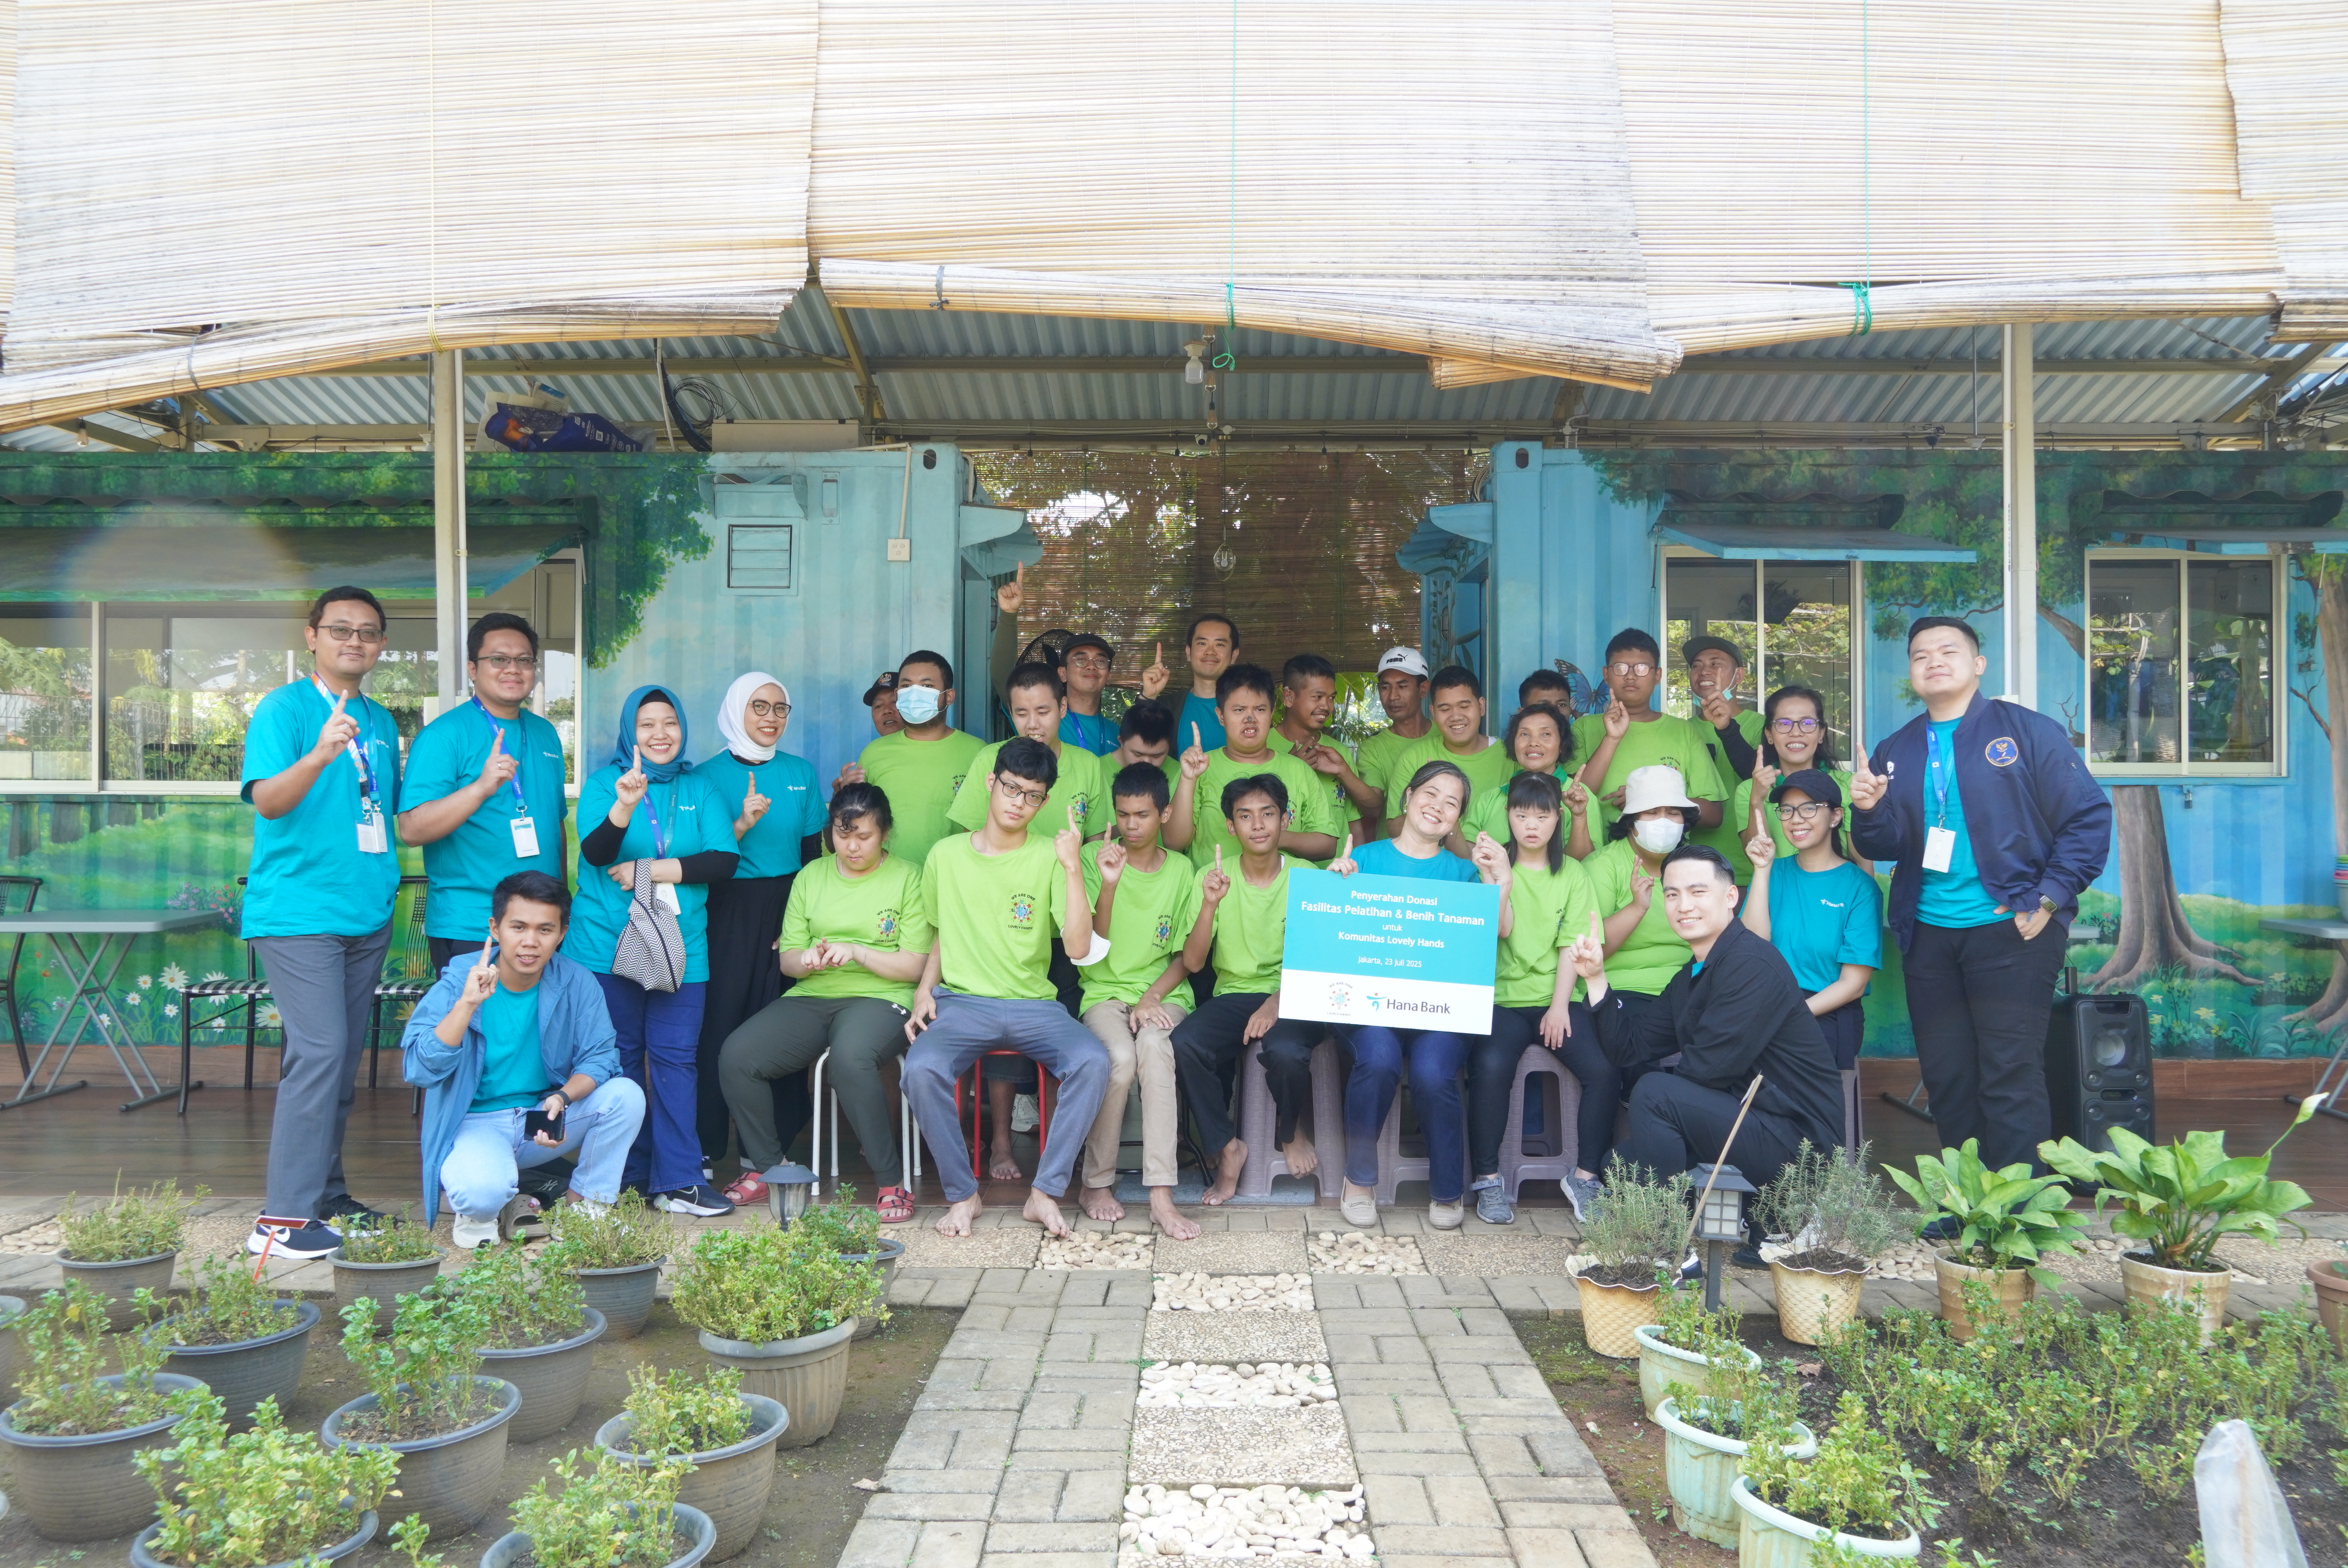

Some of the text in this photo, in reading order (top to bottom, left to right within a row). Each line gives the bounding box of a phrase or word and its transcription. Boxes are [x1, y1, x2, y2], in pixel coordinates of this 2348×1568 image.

[1351, 890, 1438, 905] Penyerahan Donasi
[1301, 901, 1484, 926] Fasilitas Pelatihan & Benih Tanaman
[1338, 931, 1444, 948] Komunitas Lovely Hands
[1358, 956, 1382, 966] Jakarta,
[1387, 999, 1450, 1014] Hana Bank
